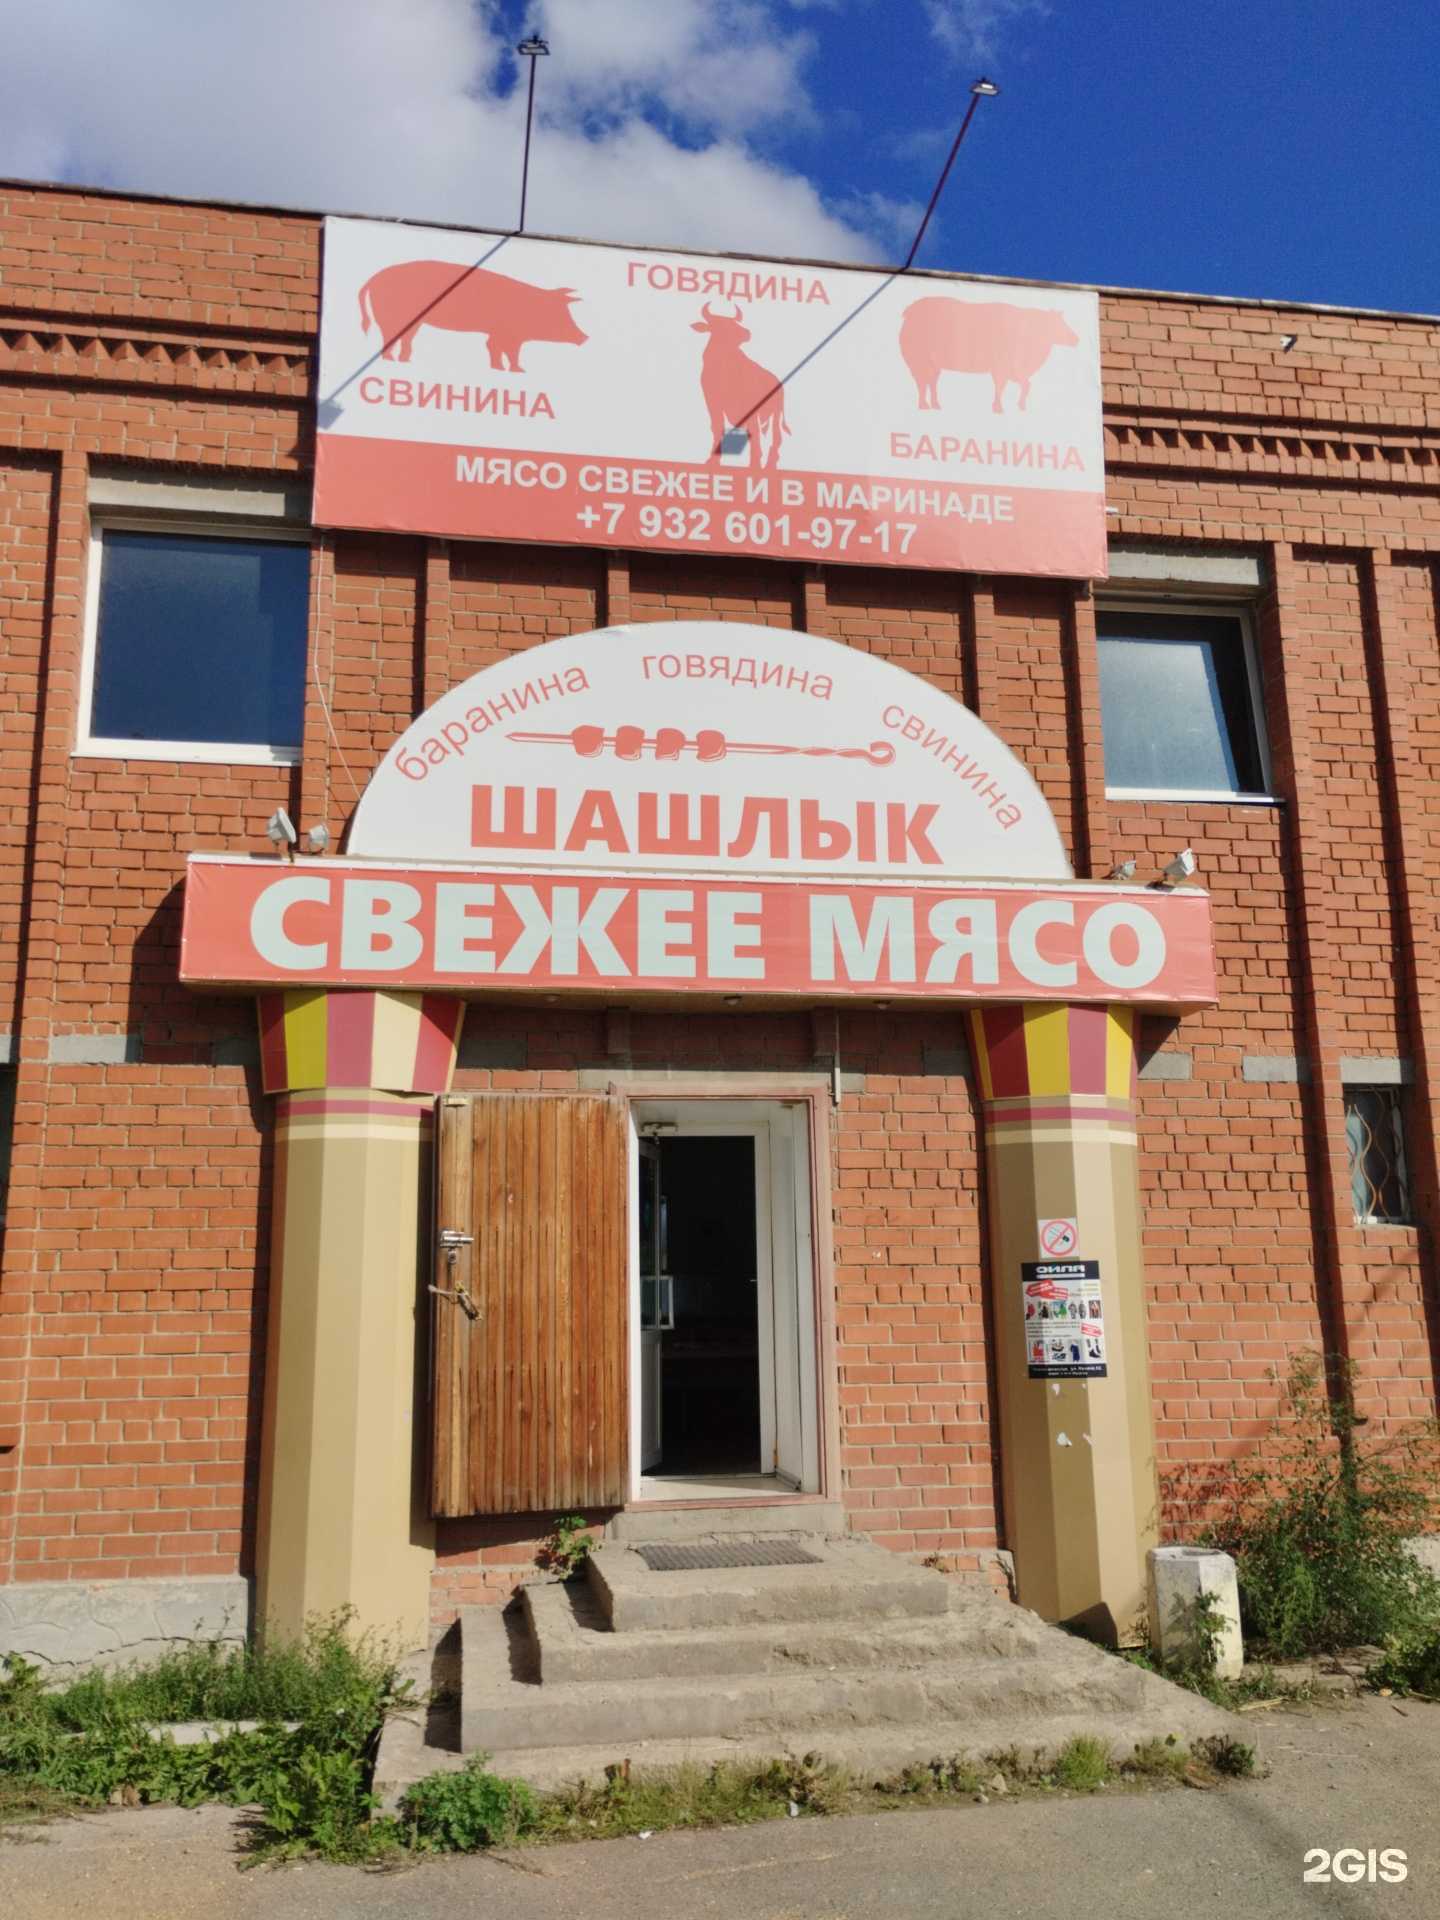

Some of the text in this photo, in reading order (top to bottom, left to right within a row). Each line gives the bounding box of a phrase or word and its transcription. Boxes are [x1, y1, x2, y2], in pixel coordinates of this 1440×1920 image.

[627, 261, 831, 305] ГОВЯДИНА
[359, 376, 556, 420] СВИНИНА
[890, 431, 1086, 473] БАРАНИНА
[455, 454, 1016, 525] МЯСО СВЕЖЕЕ И В МАРИНАДЕ
[576, 502, 918, 555] +7 932 601-97-17
[641, 654, 834, 701] говядина
[394, 662, 591, 783] баранина
[881, 703, 1023, 831] свинина
[469, 784, 944, 865] ШАШЛЫК
[249, 875, 1166, 990] СВЕЖЕЕ МЯСО
